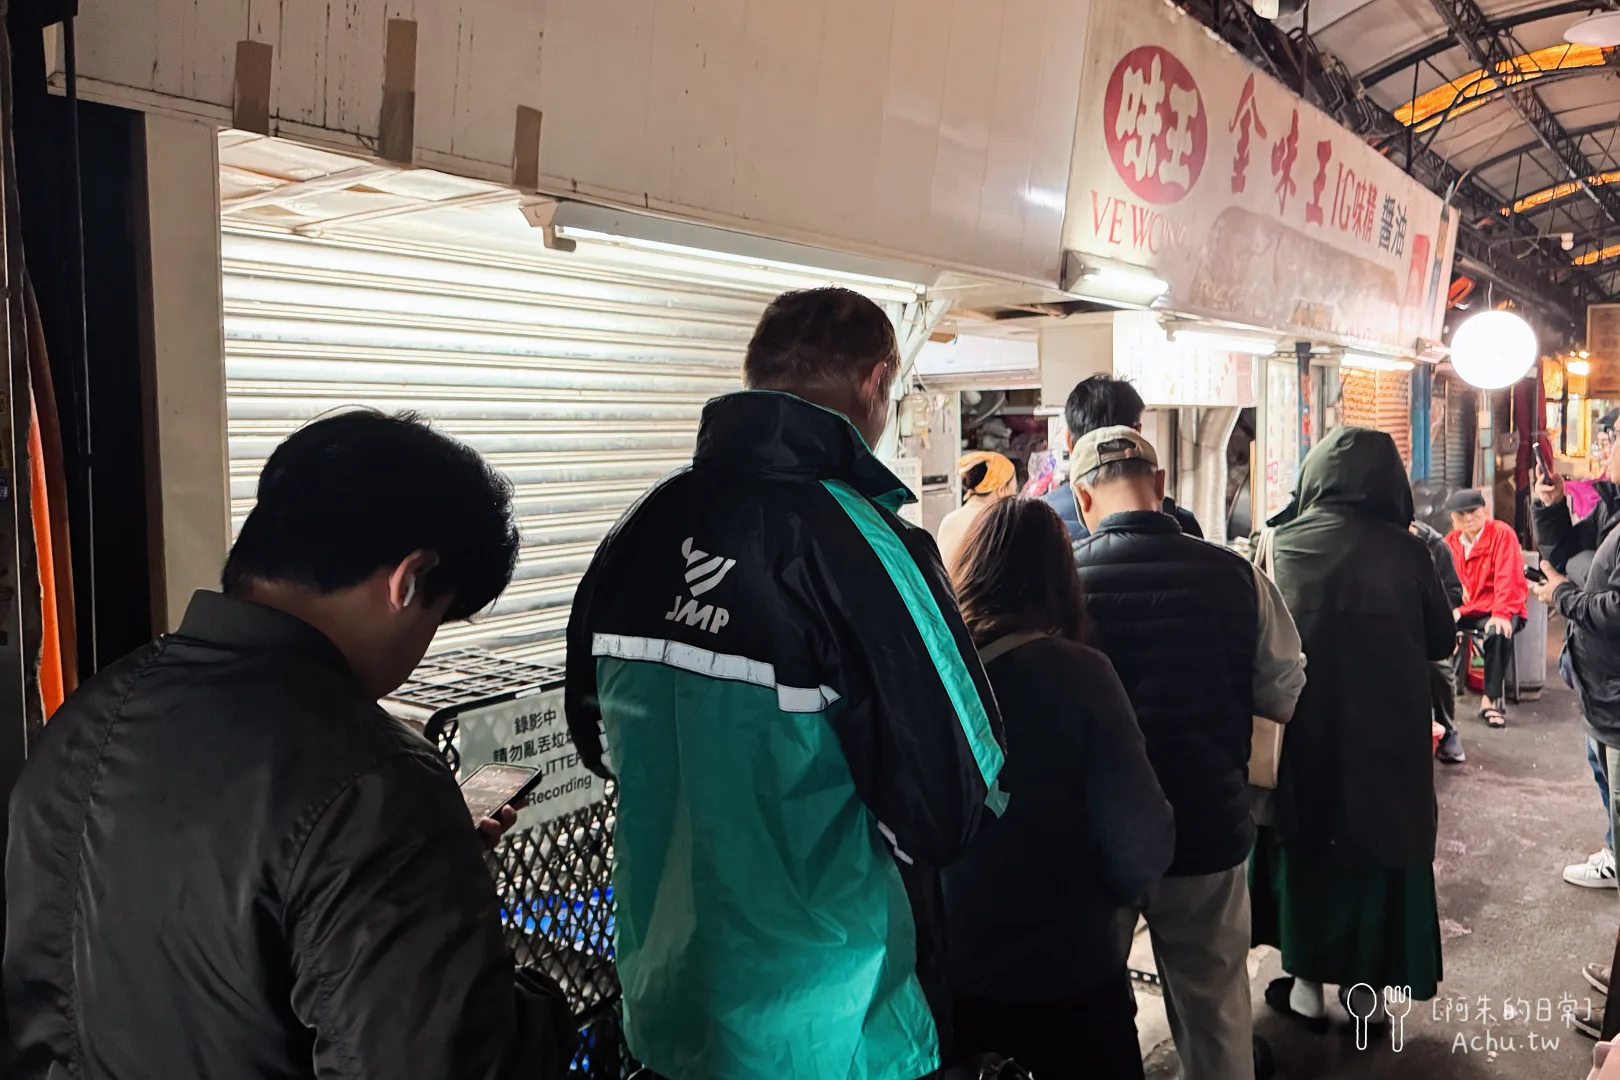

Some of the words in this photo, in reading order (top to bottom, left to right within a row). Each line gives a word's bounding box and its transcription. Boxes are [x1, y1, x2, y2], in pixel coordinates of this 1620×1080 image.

[1378, 192, 1407, 260] 醬油
[664, 595, 730, 634] JMP
[514, 708, 557, 736] 錄影中
[526, 774, 592, 806] Recording
